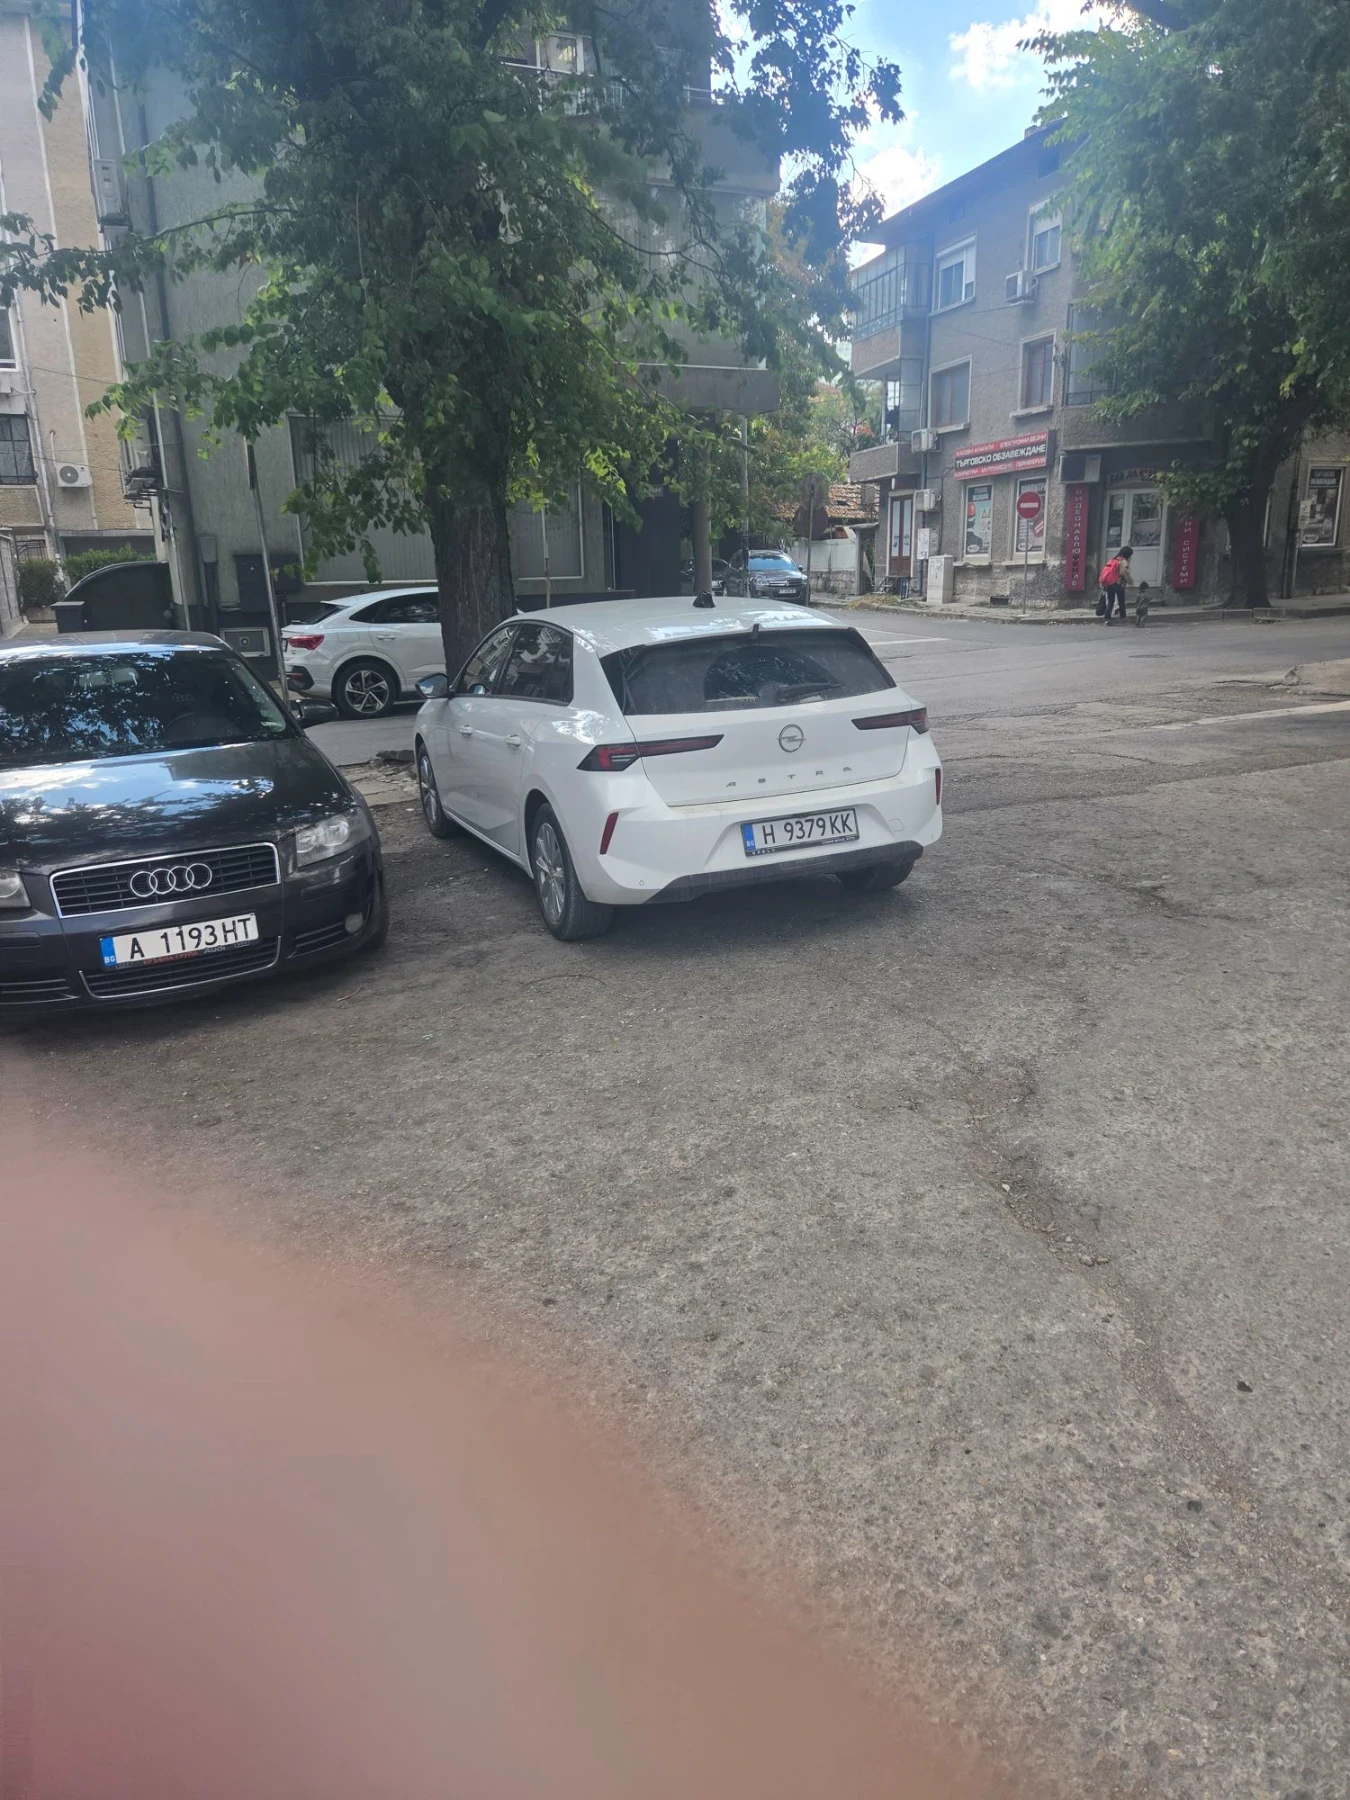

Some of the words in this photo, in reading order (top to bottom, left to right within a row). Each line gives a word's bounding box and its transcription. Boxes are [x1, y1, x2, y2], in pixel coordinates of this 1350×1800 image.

[956, 454, 991, 468] ТЪРГОВСКО
[992, 443, 1046, 462] ОБЗАВЕЖДАНЕ
[1180, 540, 1190, 584] СИСТЕМИ
[726, 766, 852, 787] ASTRA
[104, 956, 116, 964] BG
